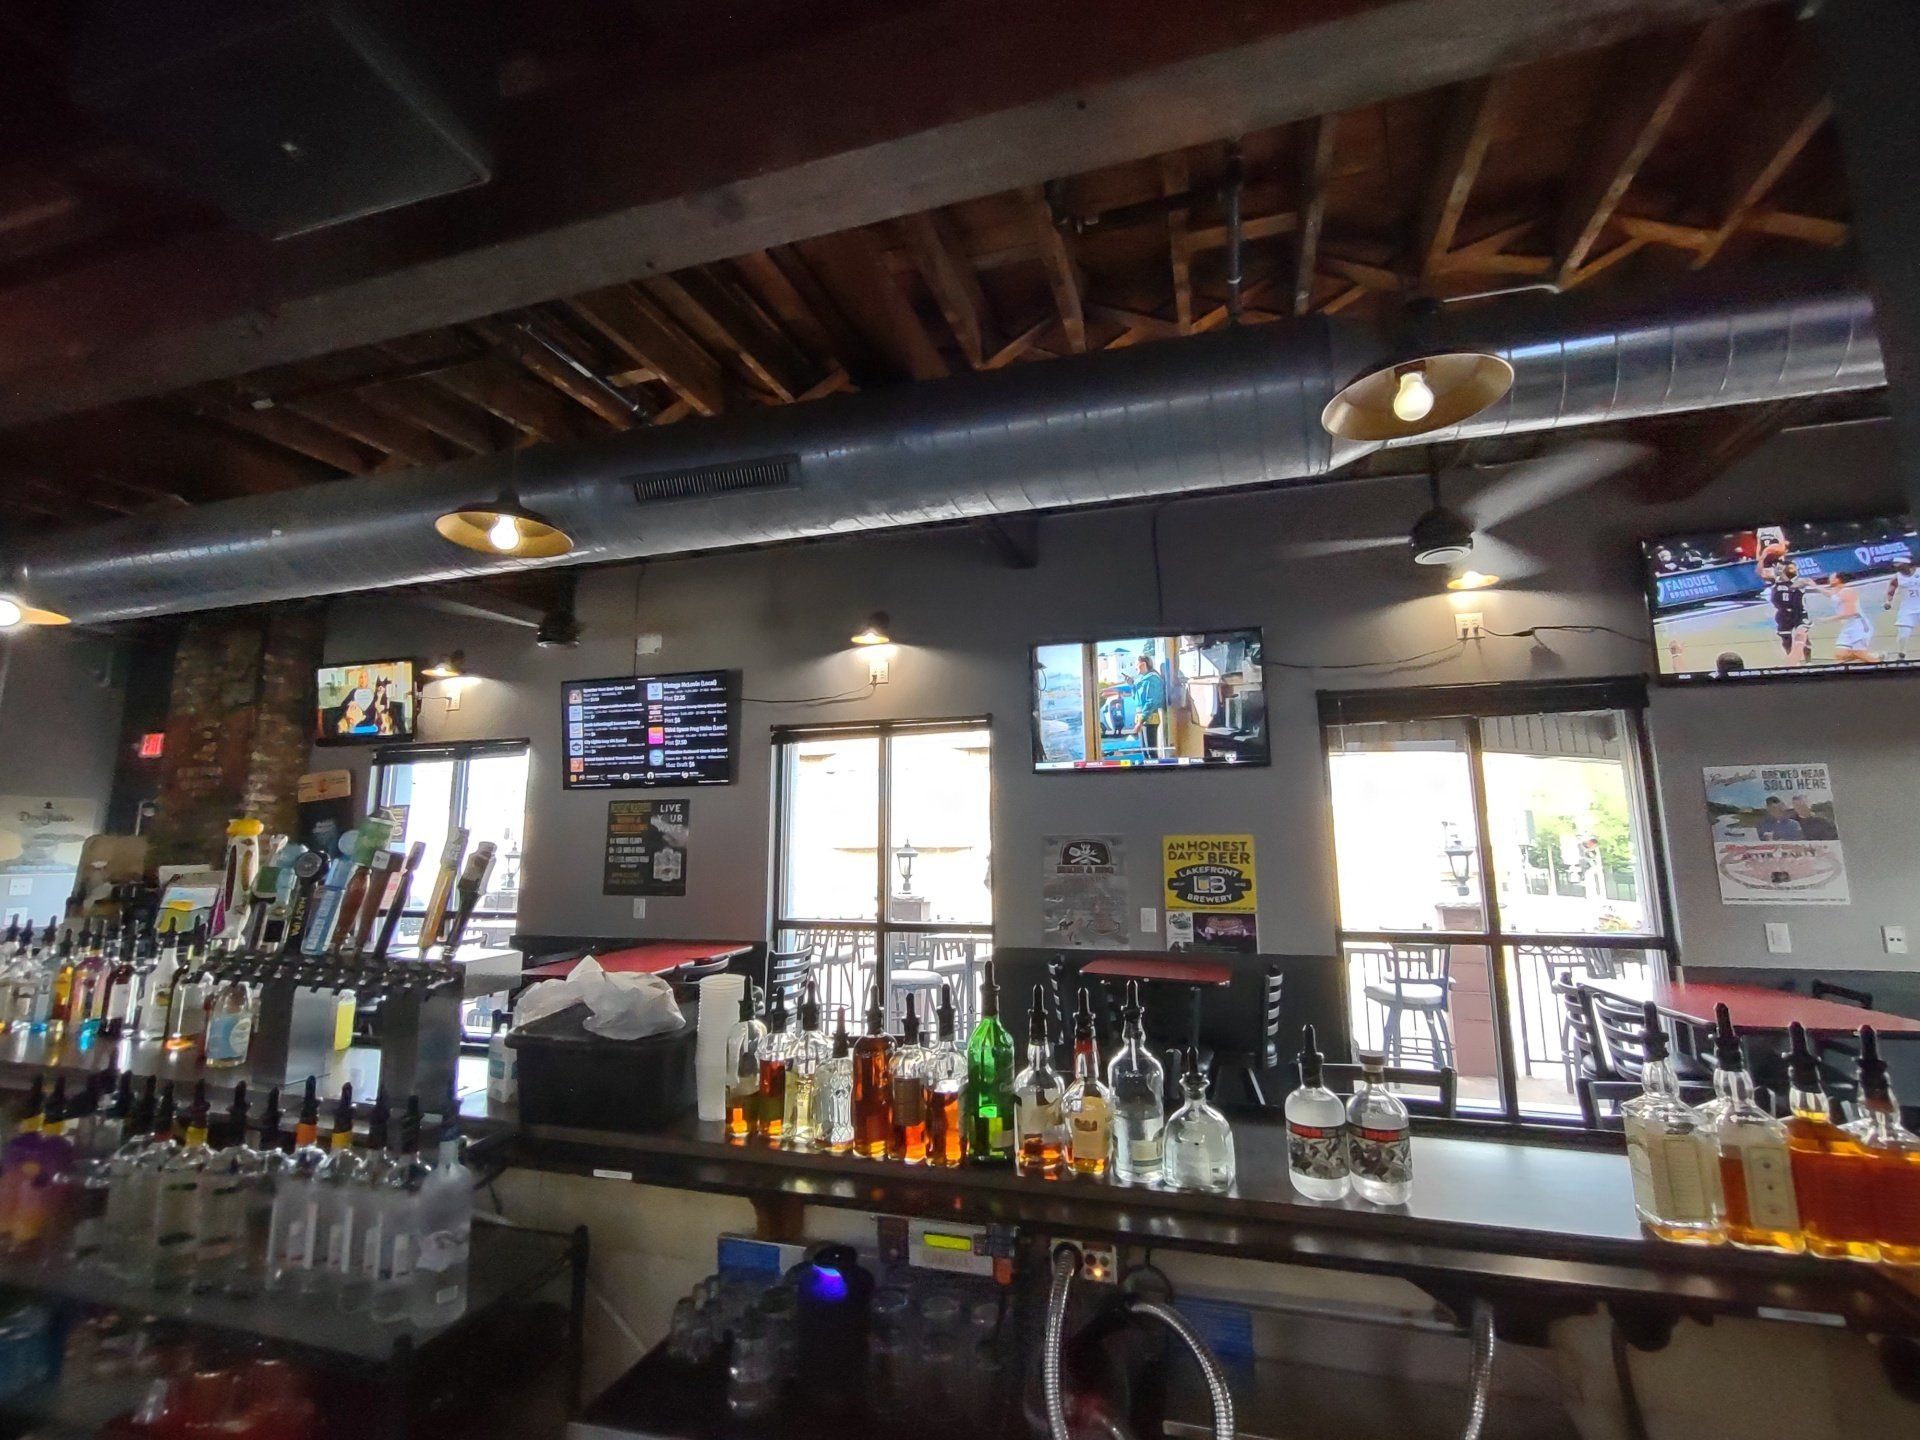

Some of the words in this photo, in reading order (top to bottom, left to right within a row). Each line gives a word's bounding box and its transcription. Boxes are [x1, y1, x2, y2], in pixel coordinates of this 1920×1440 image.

[1665, 574, 1715, 592] FANDUEL
[1761, 768, 1799, 780] BREWED
[1800, 768, 1826, 779] NEAR
[1763, 779, 1794, 791] SOLD
[1796, 778, 1827, 790] HERE
[660, 803, 682, 813] LIVE
[1167, 842, 1185, 851] AN
[1187, 840, 1248, 852] HONEST
[1168, 851, 1204, 861] DAY'S
[1207, 852, 1251, 865] BEER
[1178, 866, 1240, 878] LAKEFRONT
[1187, 893, 1233, 903] BREWERY
